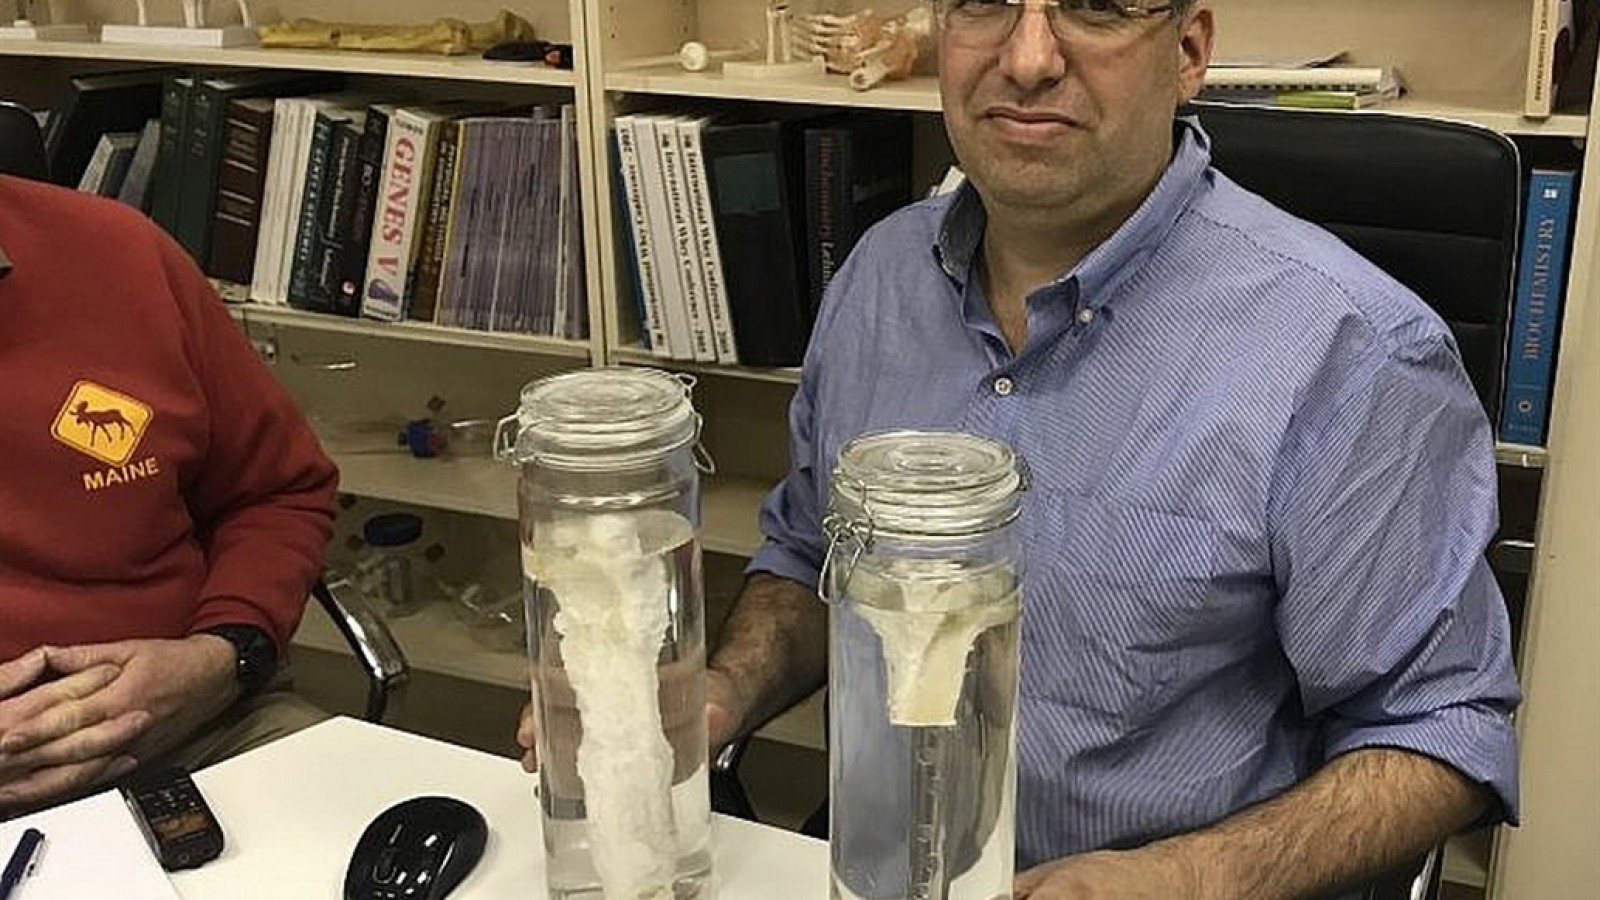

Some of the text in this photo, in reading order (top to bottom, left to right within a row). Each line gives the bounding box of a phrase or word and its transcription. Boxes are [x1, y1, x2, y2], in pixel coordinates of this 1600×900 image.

[382, 137, 415, 245] GENES
[666, 151, 686, 224] International
[687, 152, 709, 225] International
[378, 256, 399, 275] V
[1522, 216, 1555, 360] BIOCHEMISTRY
[83, 457, 160, 491] MAINE
